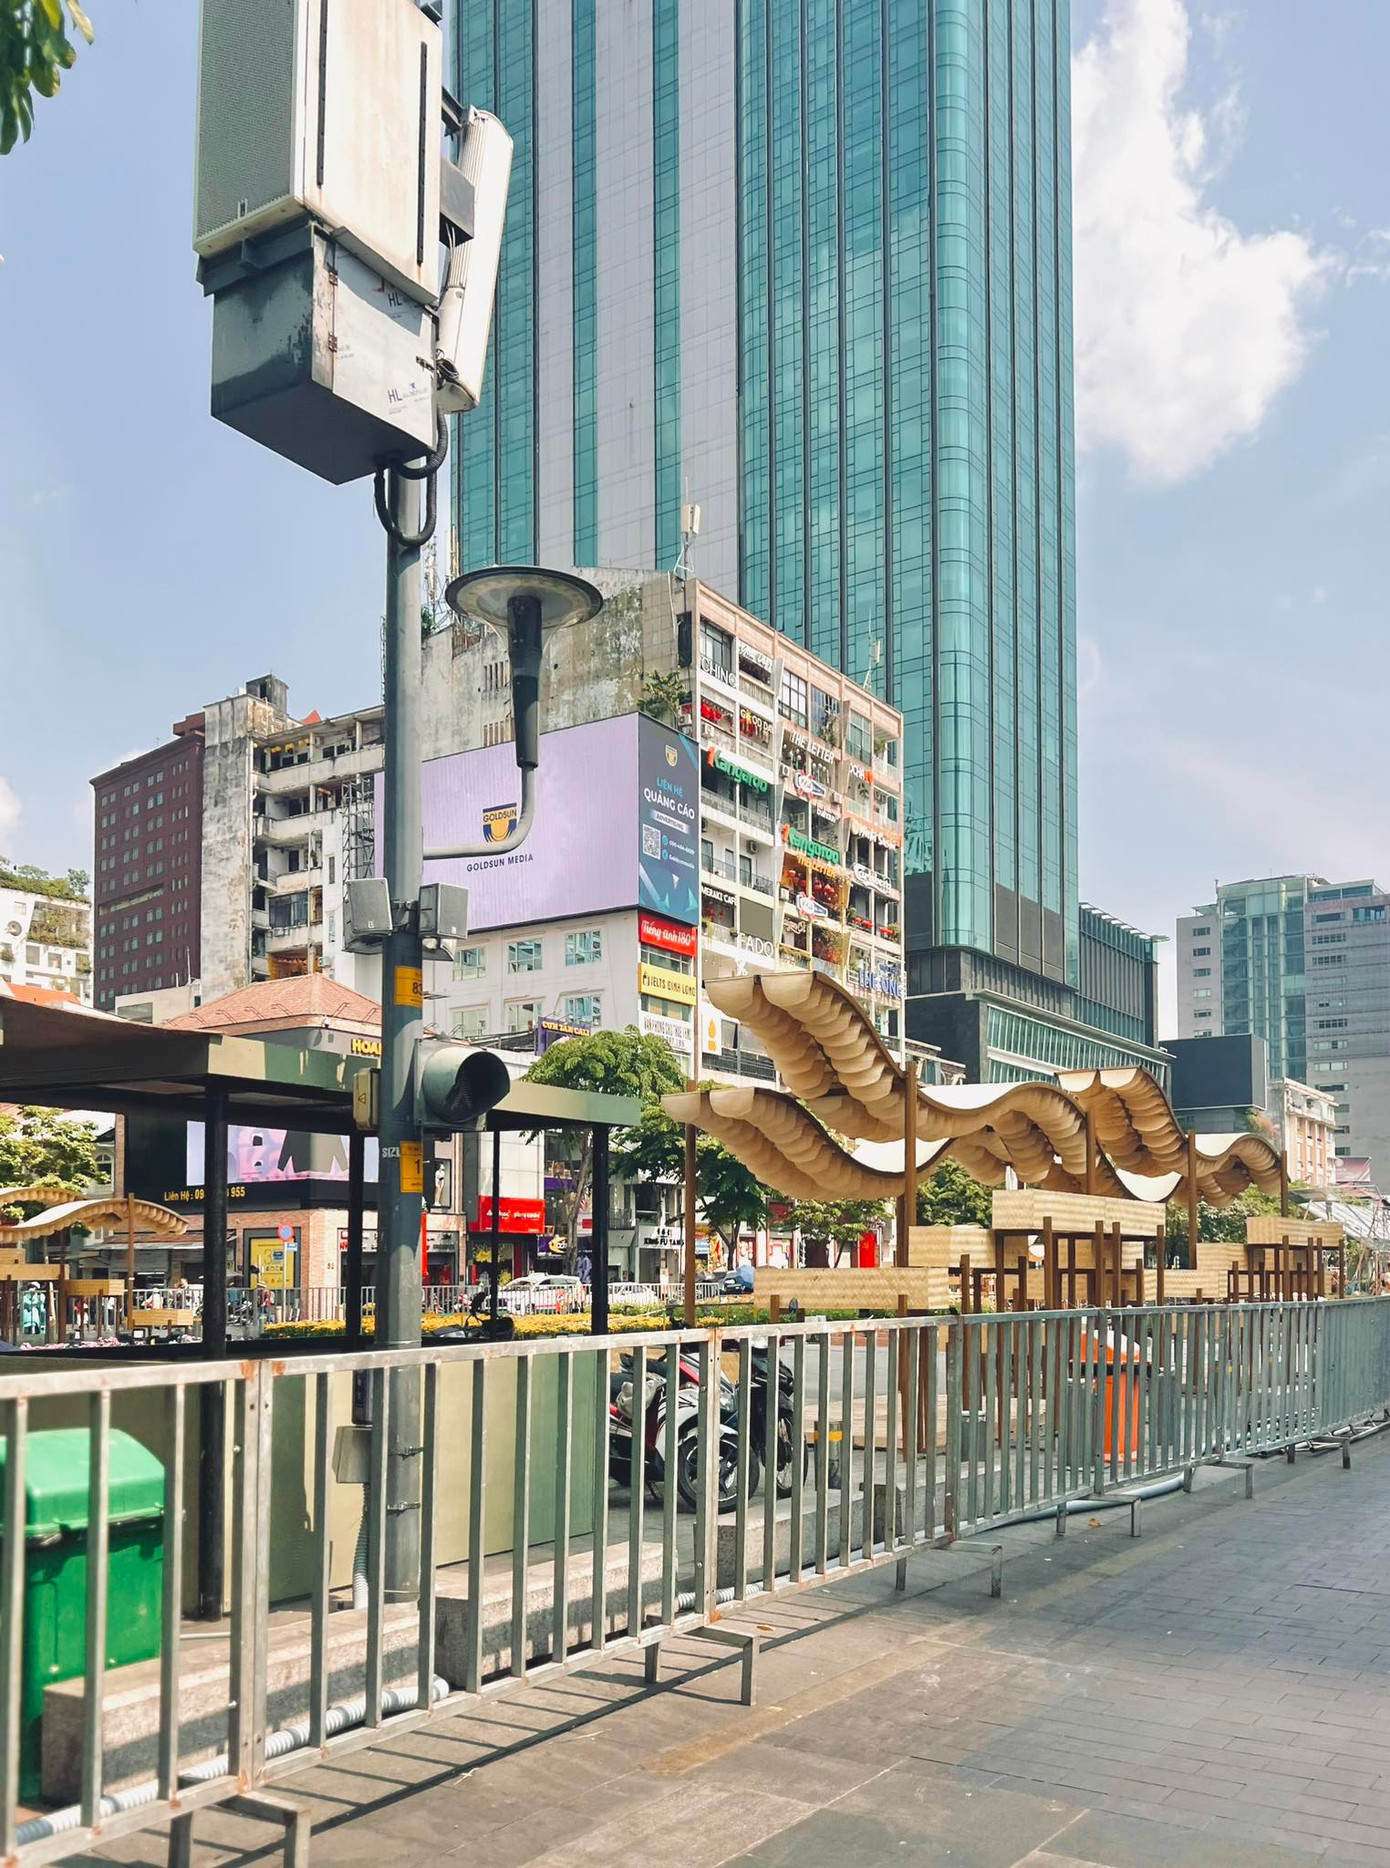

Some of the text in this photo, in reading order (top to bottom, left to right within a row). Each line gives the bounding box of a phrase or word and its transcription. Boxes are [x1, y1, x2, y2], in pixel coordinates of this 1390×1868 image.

[387, 388, 403, 404] HL
[790, 730, 835, 765] THE LETTER
[483, 809, 517, 822] GOLDSUN
[677, 803, 695, 820] CÁO
[466, 853, 534, 872] GOLDSUN MEDIA
[738, 932, 774, 958] FADO
[650, 975, 666, 989] IELTS
[163, 1191, 179, 1201] Liên
[230, 1186, 246, 1198] 955
